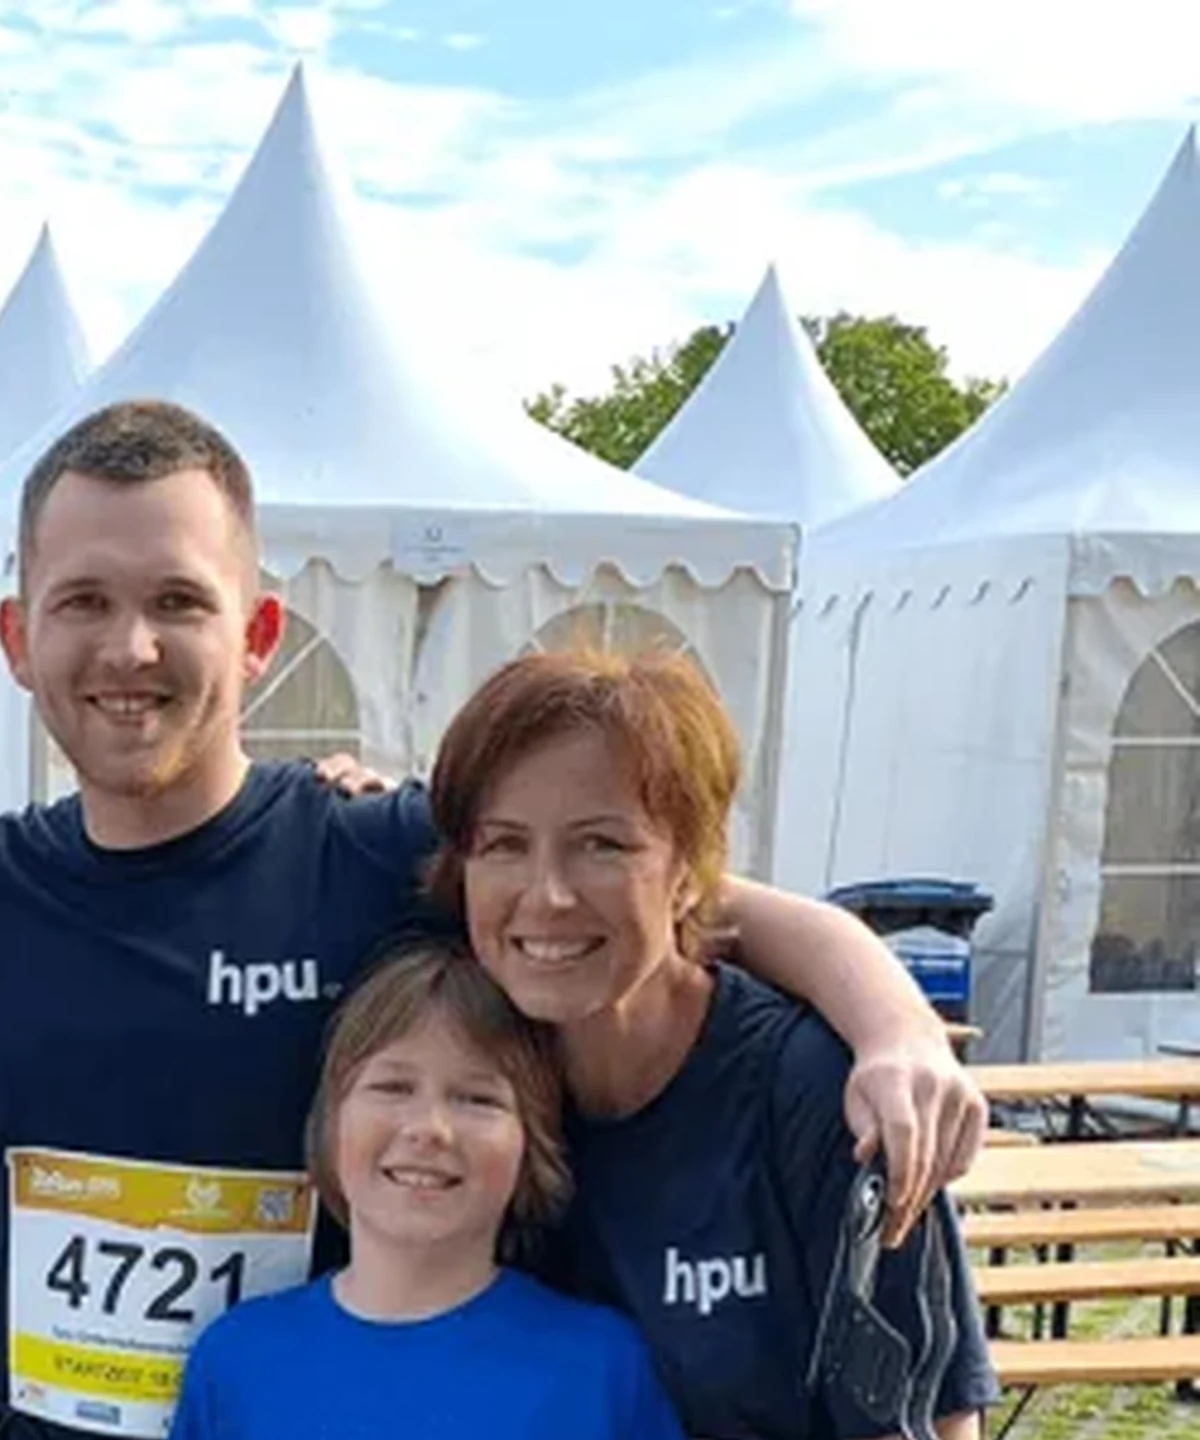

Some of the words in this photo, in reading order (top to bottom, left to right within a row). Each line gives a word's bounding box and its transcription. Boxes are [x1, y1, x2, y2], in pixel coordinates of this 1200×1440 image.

[209, 950, 318, 1015] hpu
[46, 1235, 246, 1324] 4721
[664, 1248, 767, 1315] hpu
